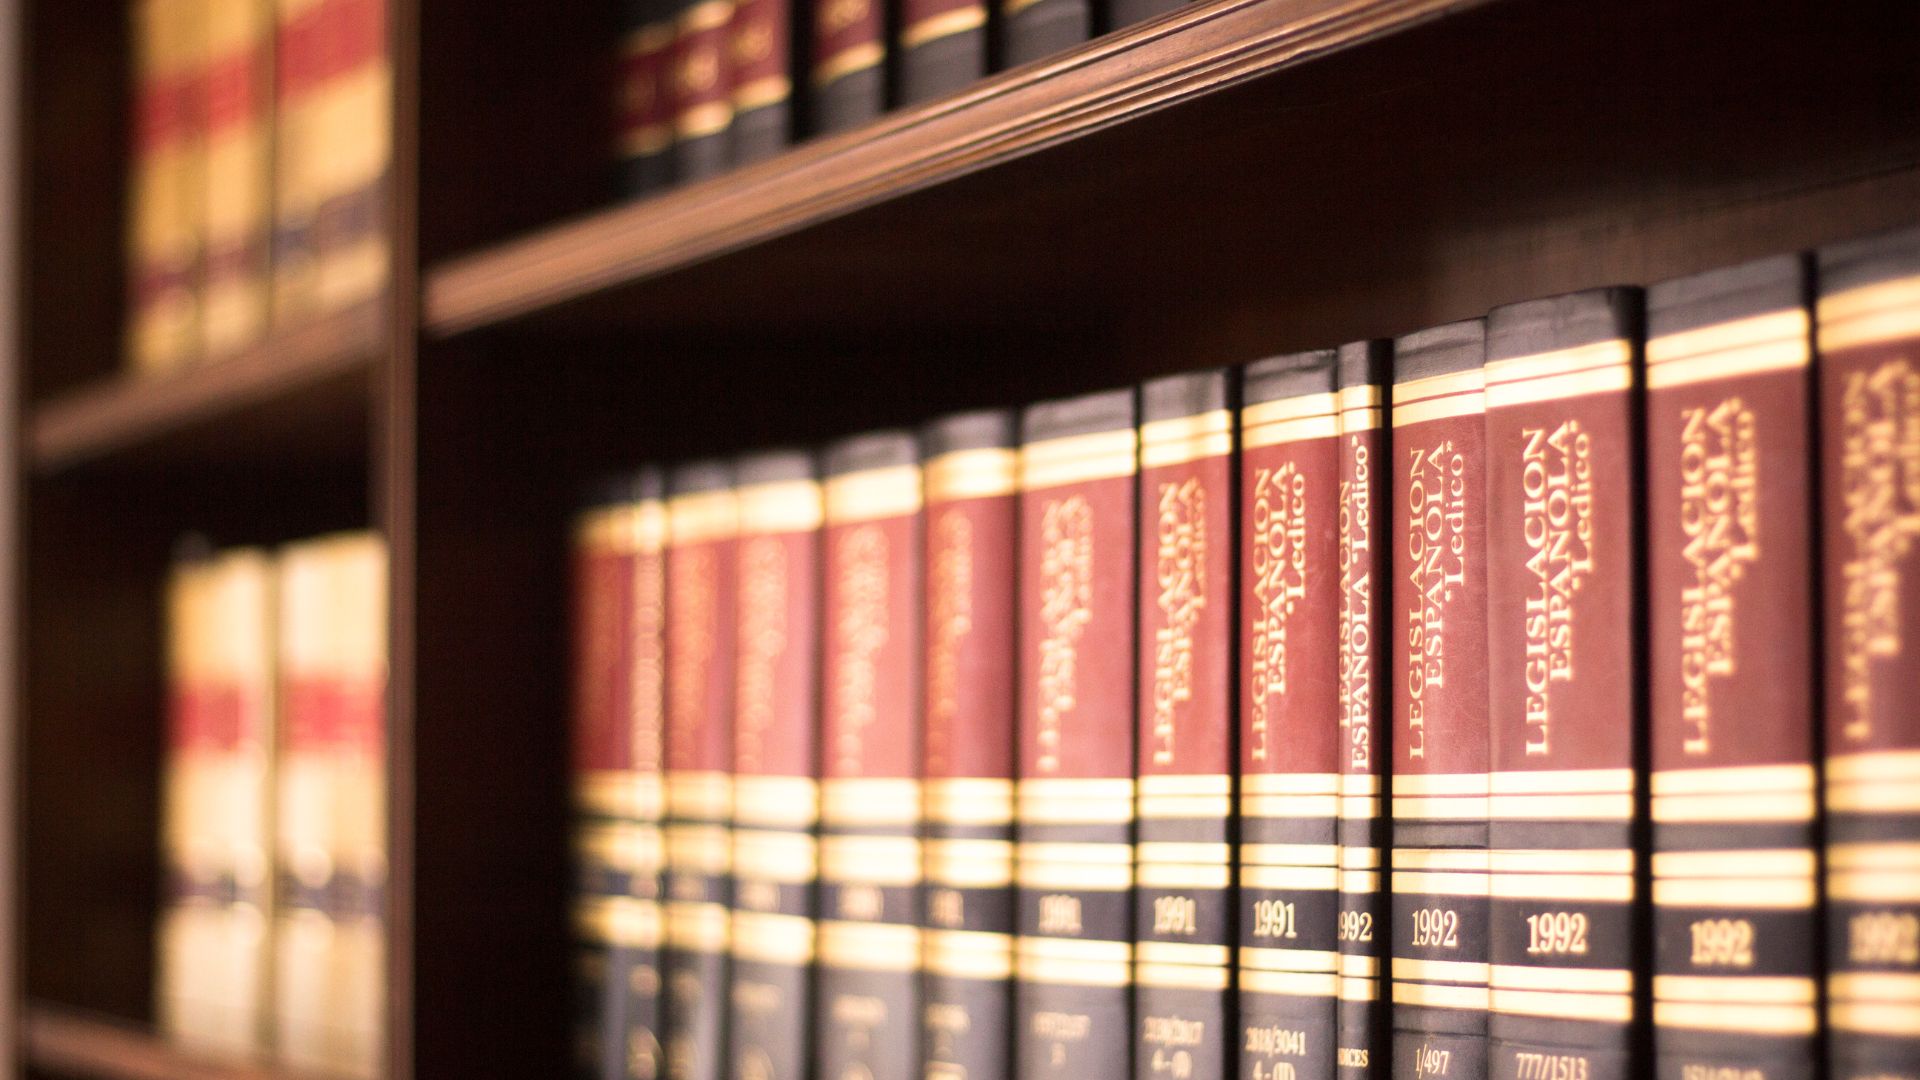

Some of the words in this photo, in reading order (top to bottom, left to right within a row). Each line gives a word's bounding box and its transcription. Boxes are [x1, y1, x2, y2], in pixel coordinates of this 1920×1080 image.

[1424, 441, 1443, 689] ESPAÑOLA
[1547, 421, 1571, 683] ESPAÑOLA
[1252, 468, 1270, 761] LEGISLACION
[1409, 447, 1425, 760] LEGISLACION
[1522, 428, 1547, 757] LEGISLACION
[1154, 896, 1197, 935] 1991
[1253, 900, 1297, 939] 1991
[1412, 909, 1458, 947] 1992
[1527, 912, 1588, 954] 1992
[1691, 919, 1755, 966] 1992
[1415, 1043, 1450, 1079] 1/497
[1515, 1052, 1588, 1080] 777/1513
